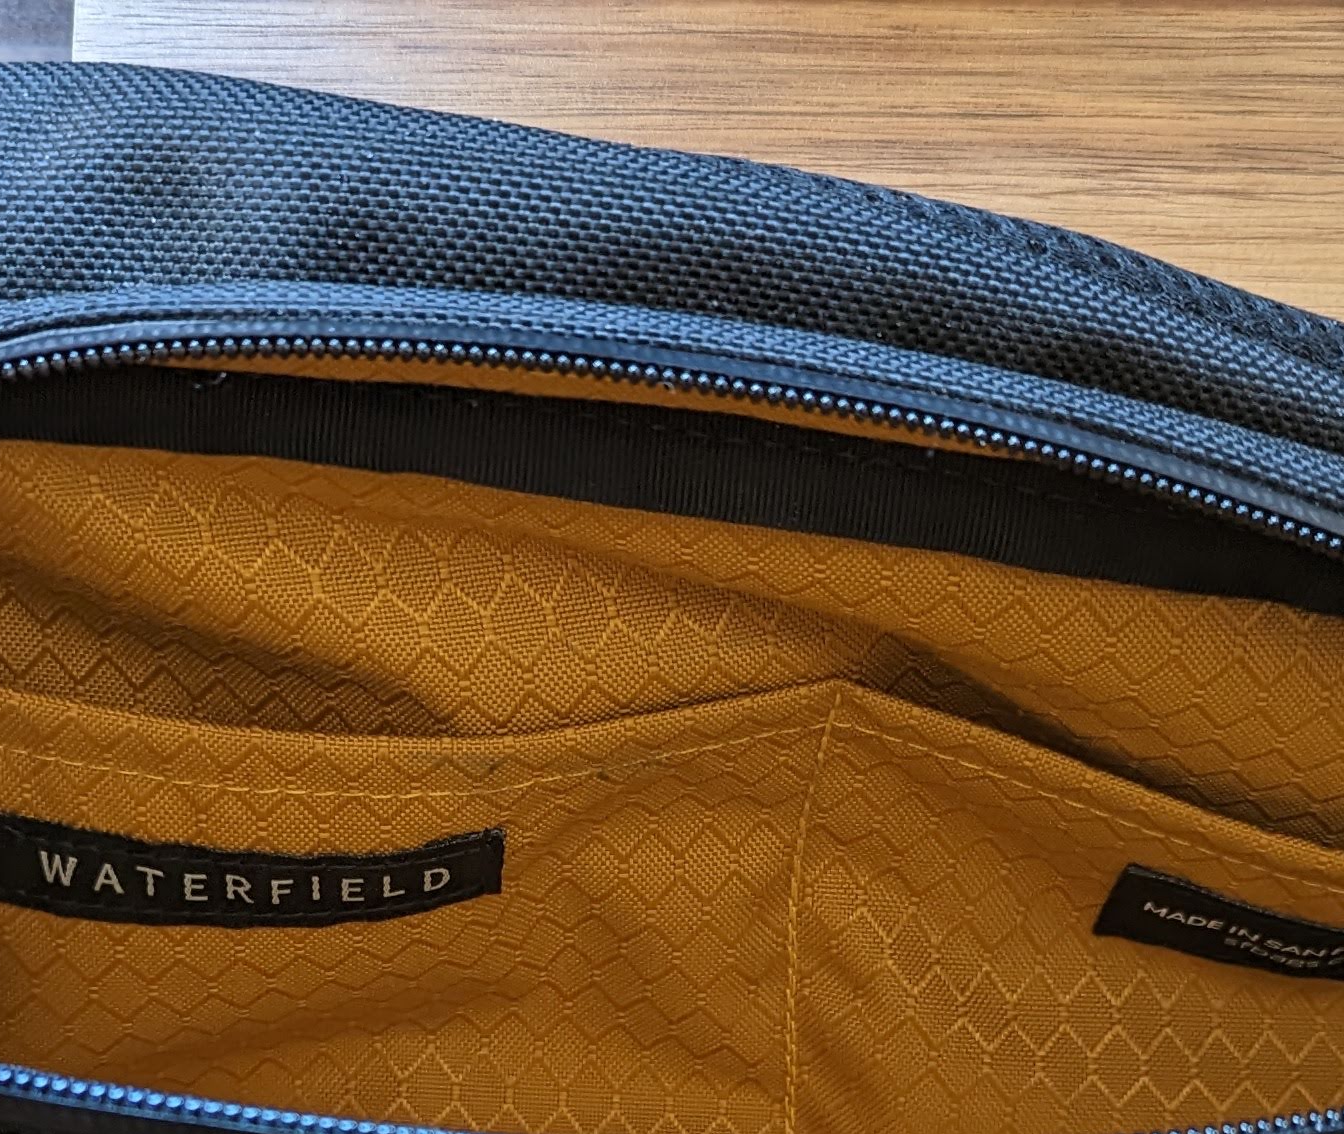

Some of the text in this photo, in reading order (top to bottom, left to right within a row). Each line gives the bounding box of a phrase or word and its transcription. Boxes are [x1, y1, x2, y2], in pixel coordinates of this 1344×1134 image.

[38, 850, 452, 905] WATERFIELD
[1143, 901, 1224, 930] MADE
[1228, 925, 1260, 942] IN
[1263, 939, 1326, 957] SAN
